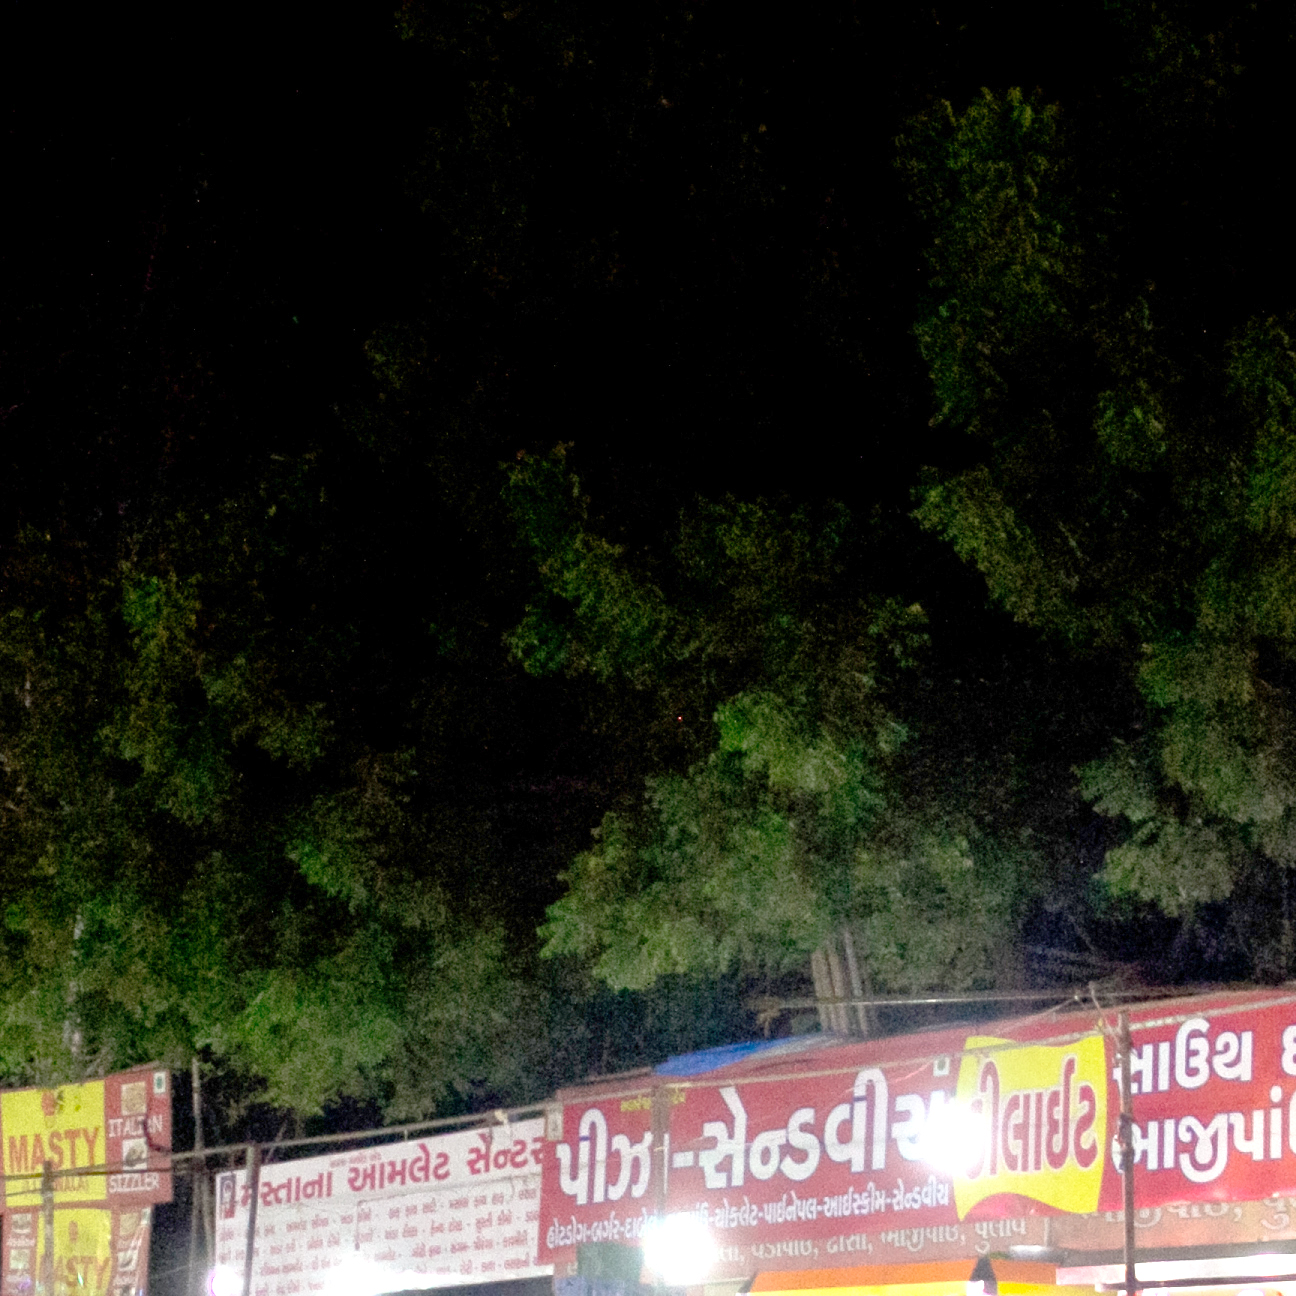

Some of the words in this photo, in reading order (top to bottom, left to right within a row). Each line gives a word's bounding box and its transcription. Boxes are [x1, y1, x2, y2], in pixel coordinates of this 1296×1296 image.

[1113, 1018, 1253, 1098] સાઉથ
[108, 1114, 164, 1139] ITALIAN
[8, 1127, 100, 1174] MASTY
[240, 1171, 333, 1207] મસ્તાના
[347, 1142, 451, 1192] આમલેટ
[466, 1132, 547, 1176] સેન્ટર
[108, 1173, 161, 1194] SIZZLER
